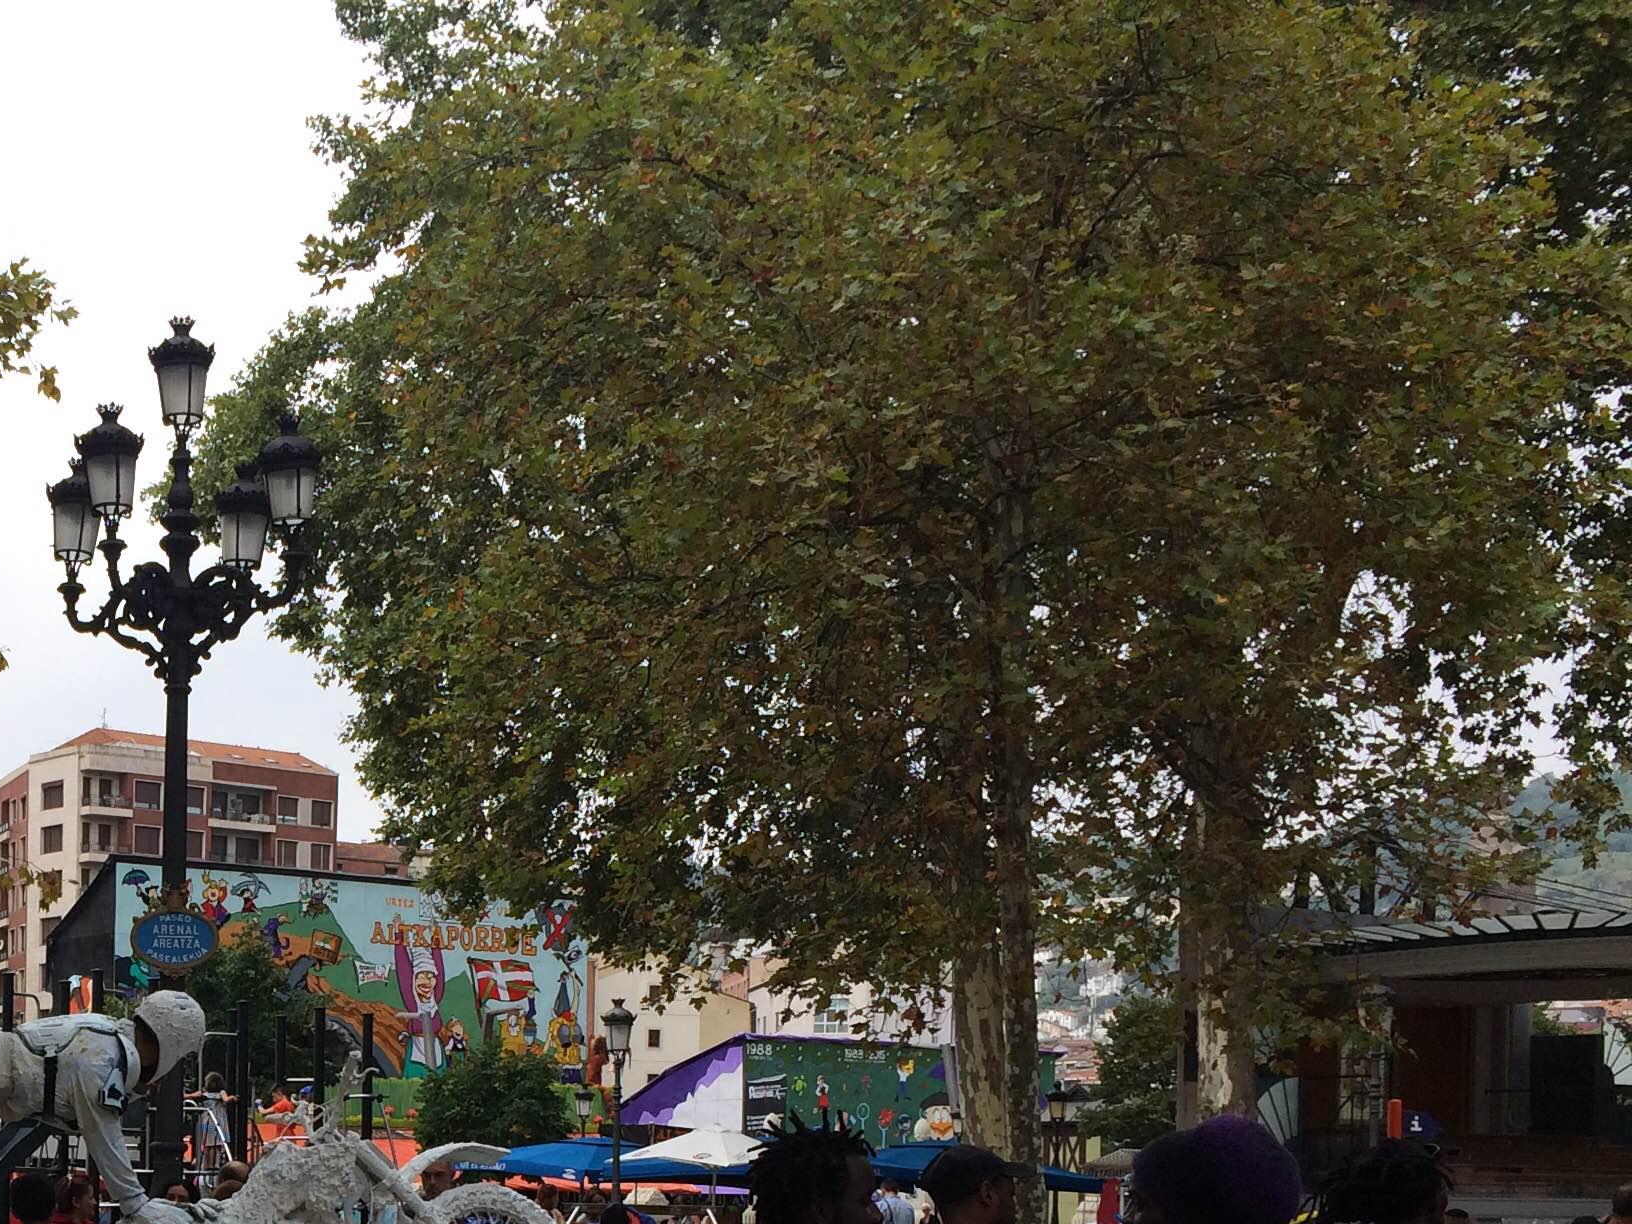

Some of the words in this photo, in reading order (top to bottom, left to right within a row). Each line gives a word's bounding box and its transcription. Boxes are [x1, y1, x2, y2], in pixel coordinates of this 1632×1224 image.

[159, 913, 192, 923] PASEO
[152, 924, 200, 935] ARENAL
[152, 938, 200, 949] AREATZA
[145, 947, 209, 963] PASEALEKUA
[746, 1043, 773, 1056] 1988
